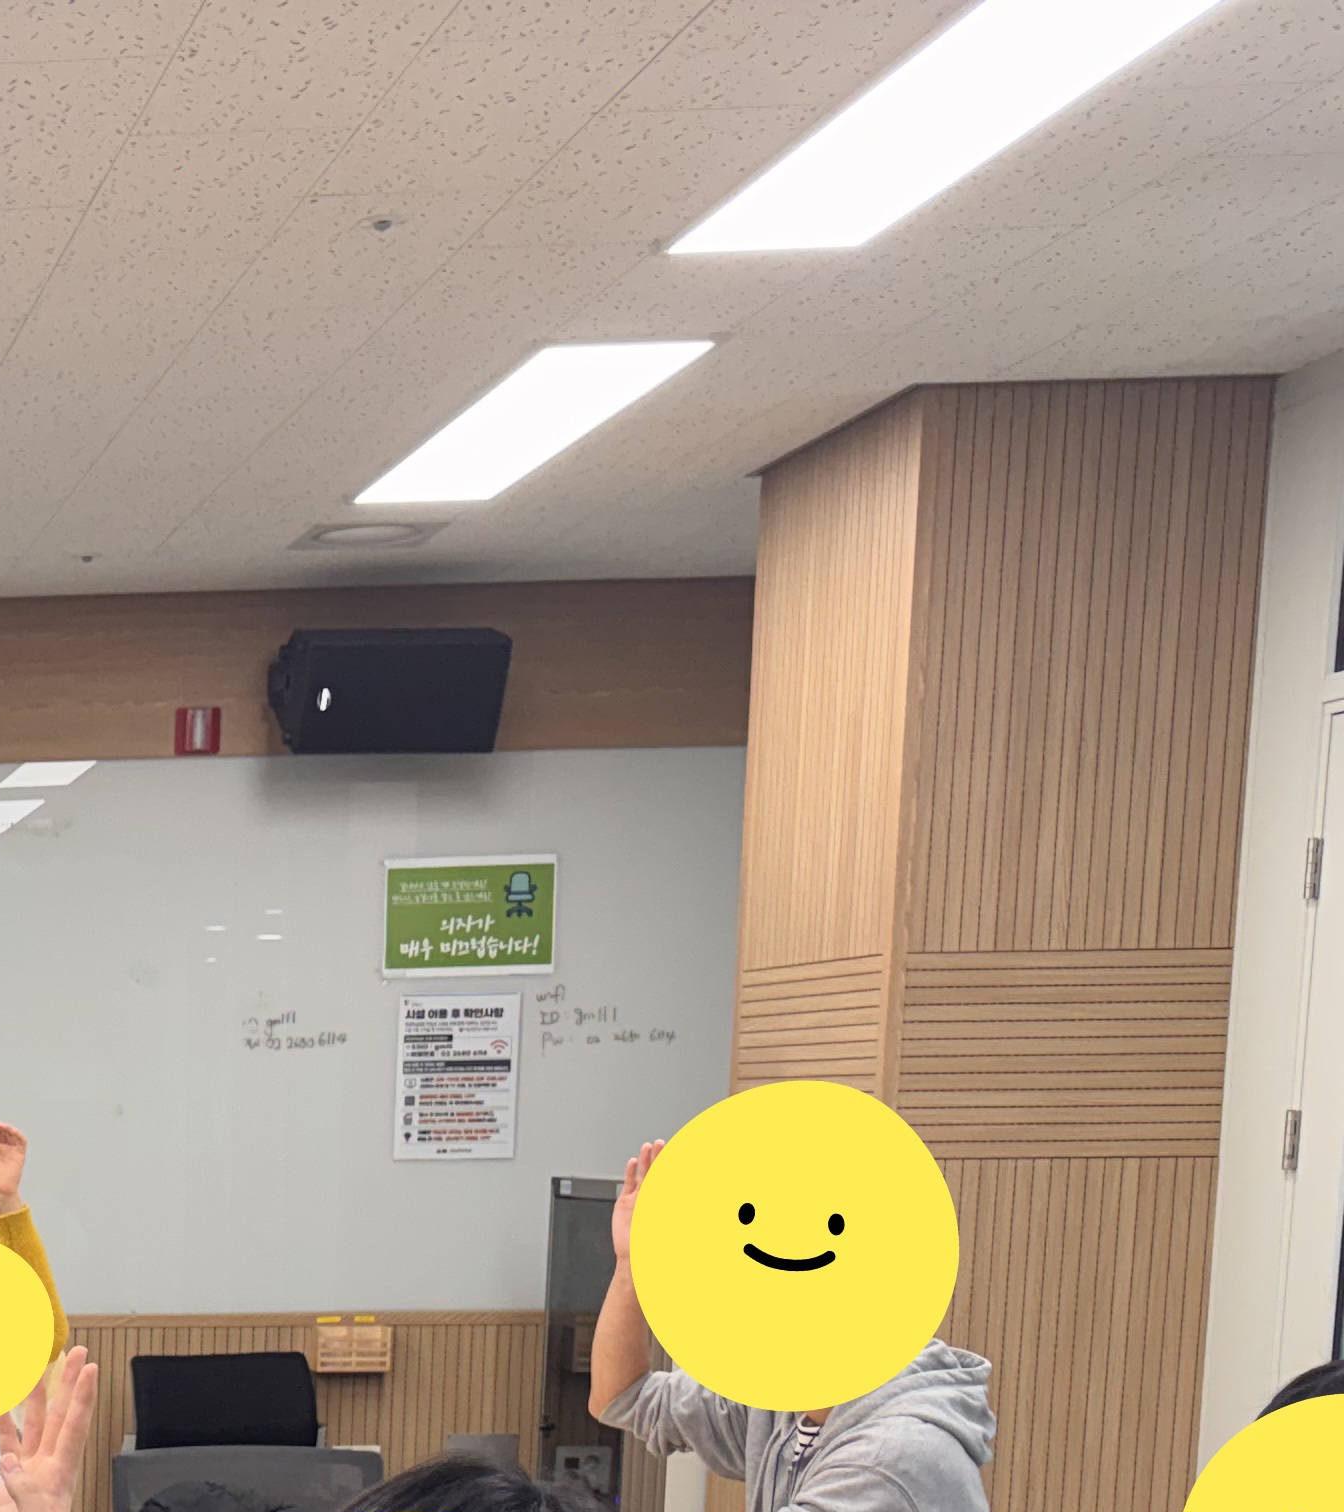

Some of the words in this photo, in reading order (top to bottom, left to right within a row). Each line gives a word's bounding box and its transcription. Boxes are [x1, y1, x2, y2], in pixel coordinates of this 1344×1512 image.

[439, 914, 496, 935] 의자가
[399, 937, 434, 961] 매우
[439, 933, 541, 960] 미끄럽습니다!
[405, 1008, 426, 1019] 시설
[463, 1007, 505, 1018] 확인사항
